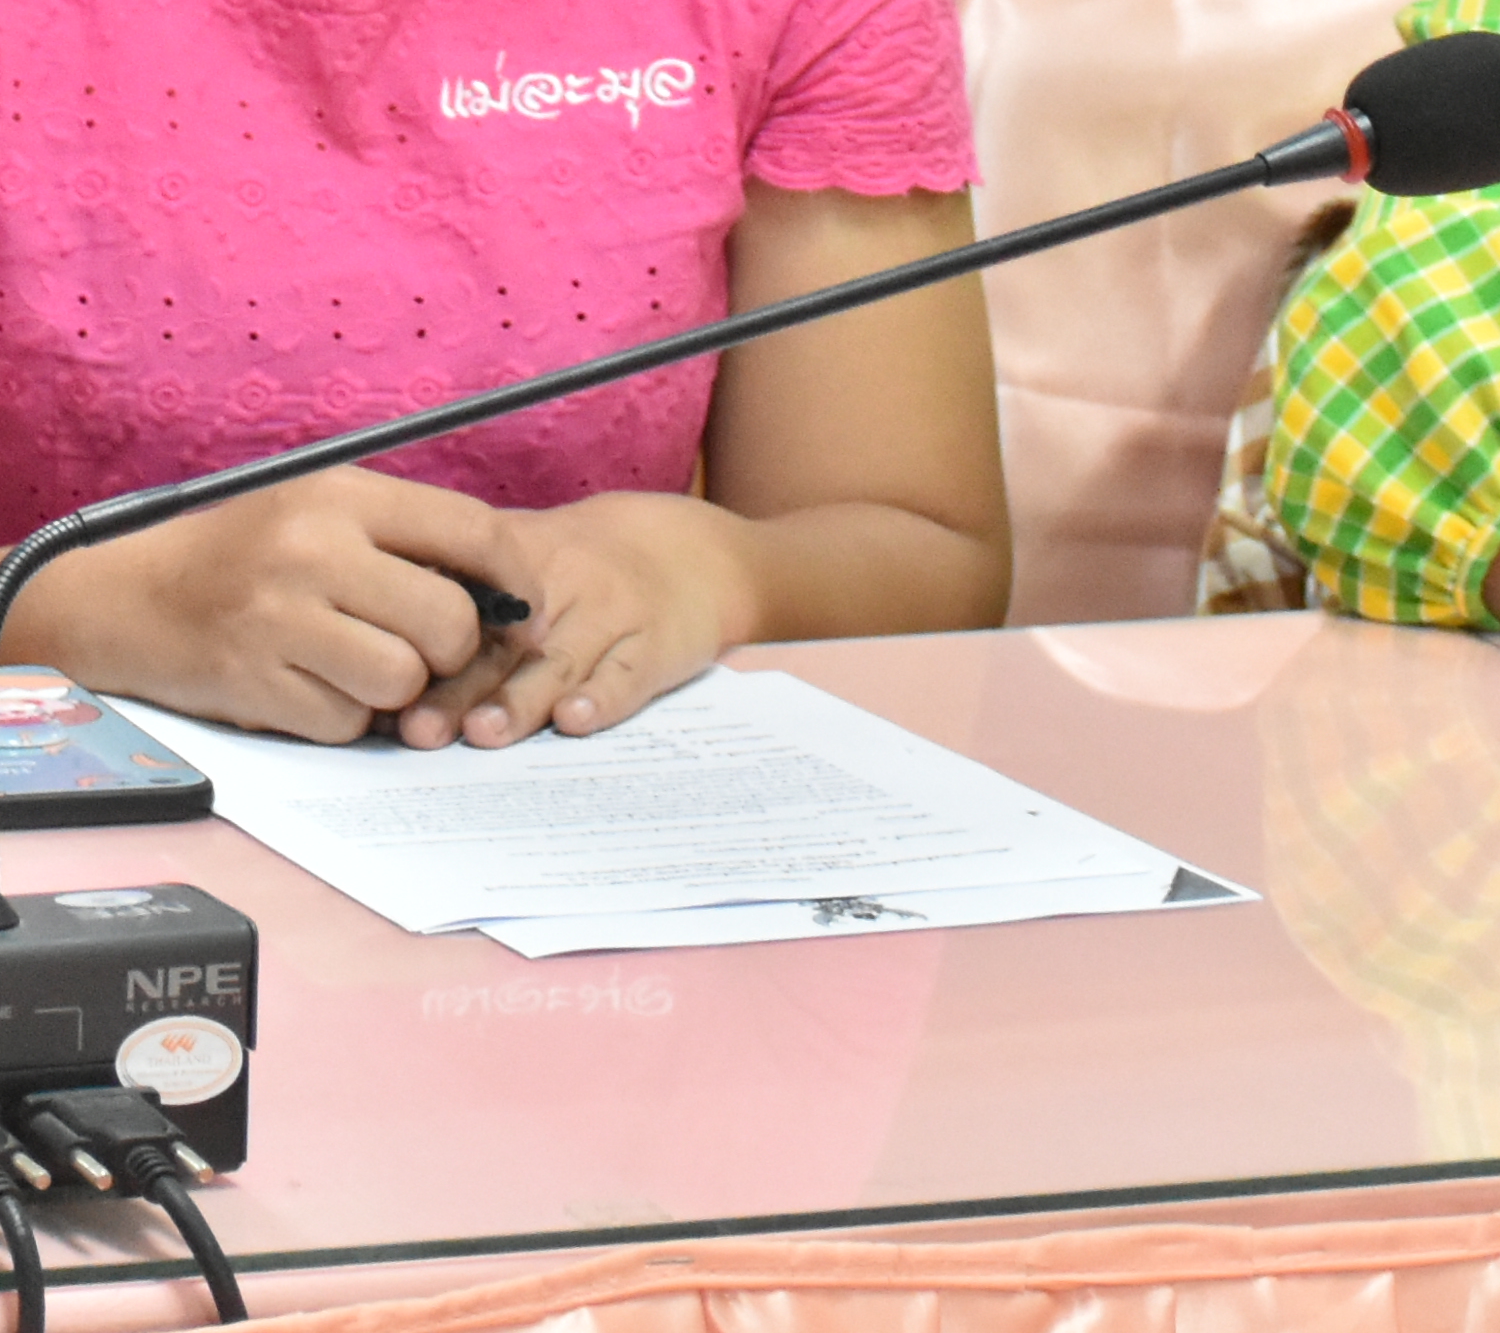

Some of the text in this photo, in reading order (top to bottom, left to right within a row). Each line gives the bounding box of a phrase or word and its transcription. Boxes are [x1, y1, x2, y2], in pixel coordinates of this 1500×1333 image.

[126, 963, 242, 1001] NPE
[125, 996, 242, 1013] RESEARCH
[147, 1054, 212, 1068] THAILAND
